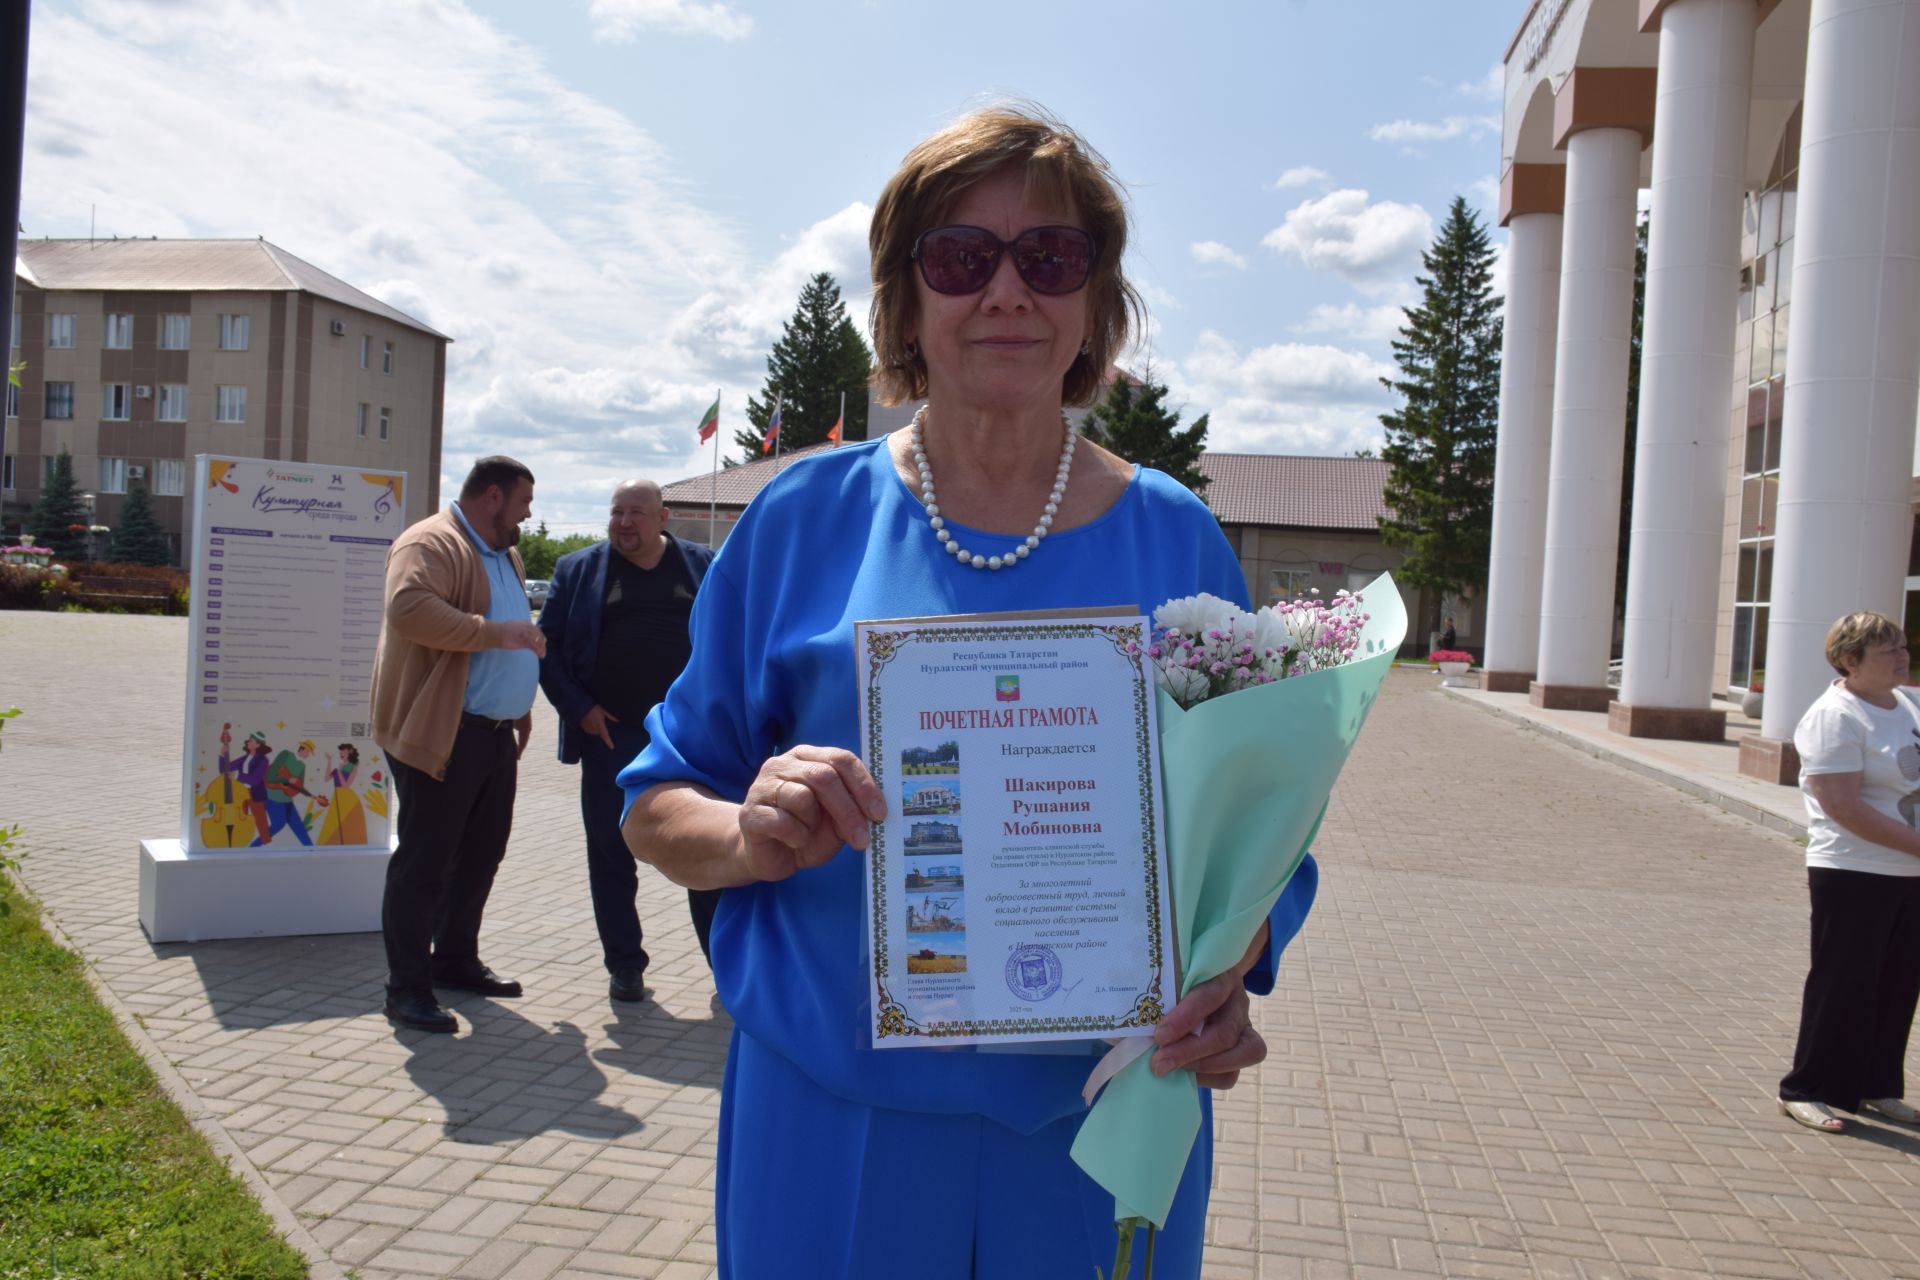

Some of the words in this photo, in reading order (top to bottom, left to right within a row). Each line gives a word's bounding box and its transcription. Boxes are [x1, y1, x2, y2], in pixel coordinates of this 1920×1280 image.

[252, 485, 343, 513] Культурная
[953, 651, 1007, 661] Республика
[1009, 650, 1058, 660] Татарстан
[921, 663, 978, 675] Нурлатский
[981, 661, 1058, 673] муниципальный
[1060, 661, 1088, 671] район
[920, 709, 1014, 730] ПОЧЕТНАЯ
[1019, 706, 1098, 728] ГРАМОТА
[1001, 744, 1096, 758] Награждается
[1005, 778, 1096, 795] Шакирова
[1013, 800, 1091, 817] Рушания
[1003, 821, 1102, 836] Мобиновна
[1019, 880, 1029, 888] За
[1031, 877, 1092, 888] многолетний
[985, 891, 1062, 904] добросовестный
[1064, 891, 1090, 901] труд,
[1093, 889, 1126, 898] личный
[995, 905, 1021, 914] вклад
[1030, 904, 1074, 915] развитие
[1076, 903, 1117, 911] системы
[994, 918, 1051, 928] социального
[1053, 915, 1119, 926] обслуживания
[1034, 929, 1080, 938] населения
[1075, 940, 1108, 951] районе
